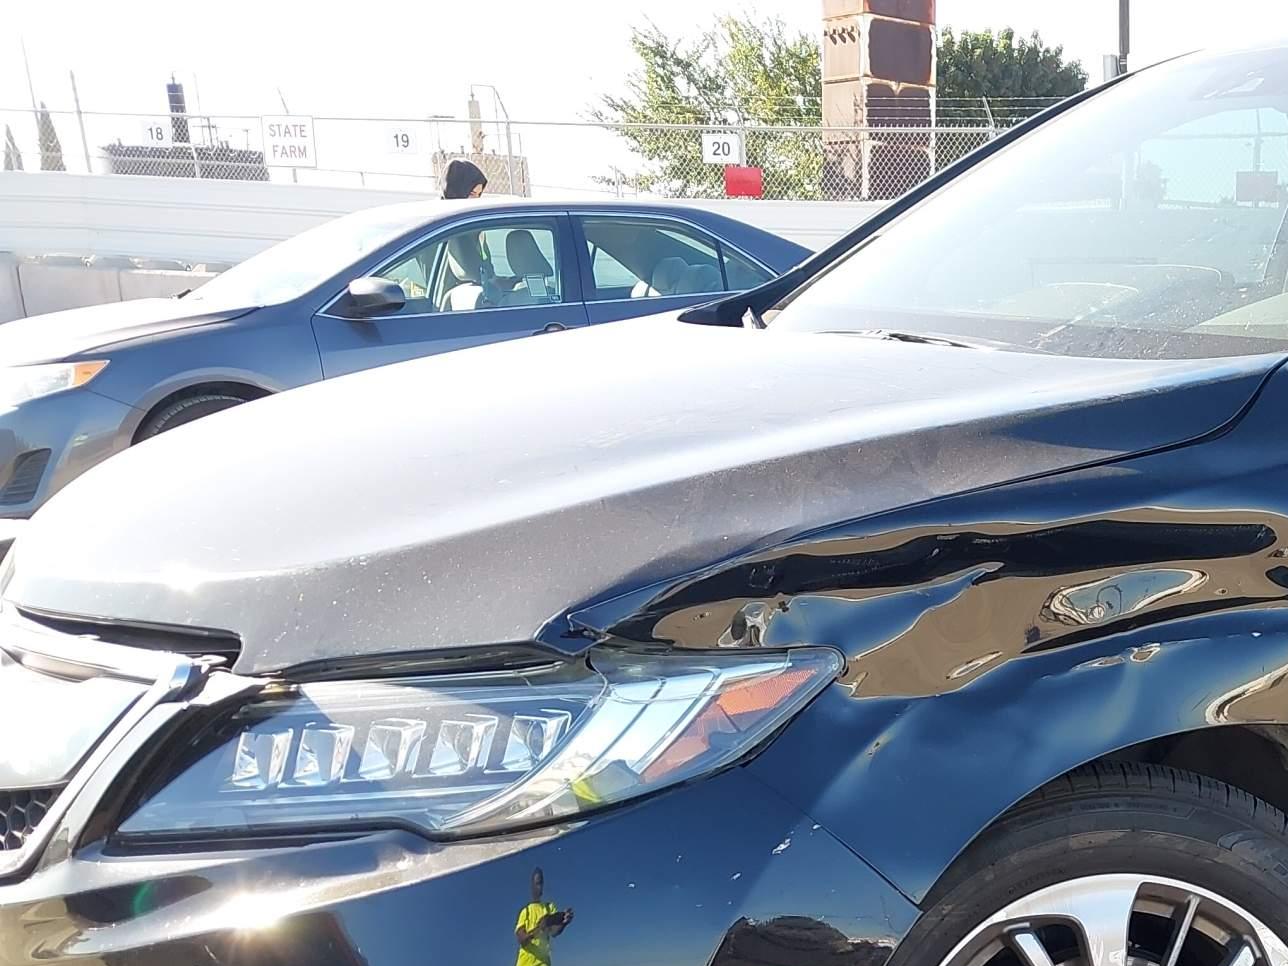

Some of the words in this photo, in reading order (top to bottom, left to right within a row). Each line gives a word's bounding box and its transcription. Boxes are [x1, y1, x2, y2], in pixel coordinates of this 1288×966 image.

[147, 126, 164, 141] 18
[268, 124, 308, 139] STATE
[393, 133, 410, 148] 19
[271, 144, 308, 160] FARM
[711, 141, 731, 157] 20
